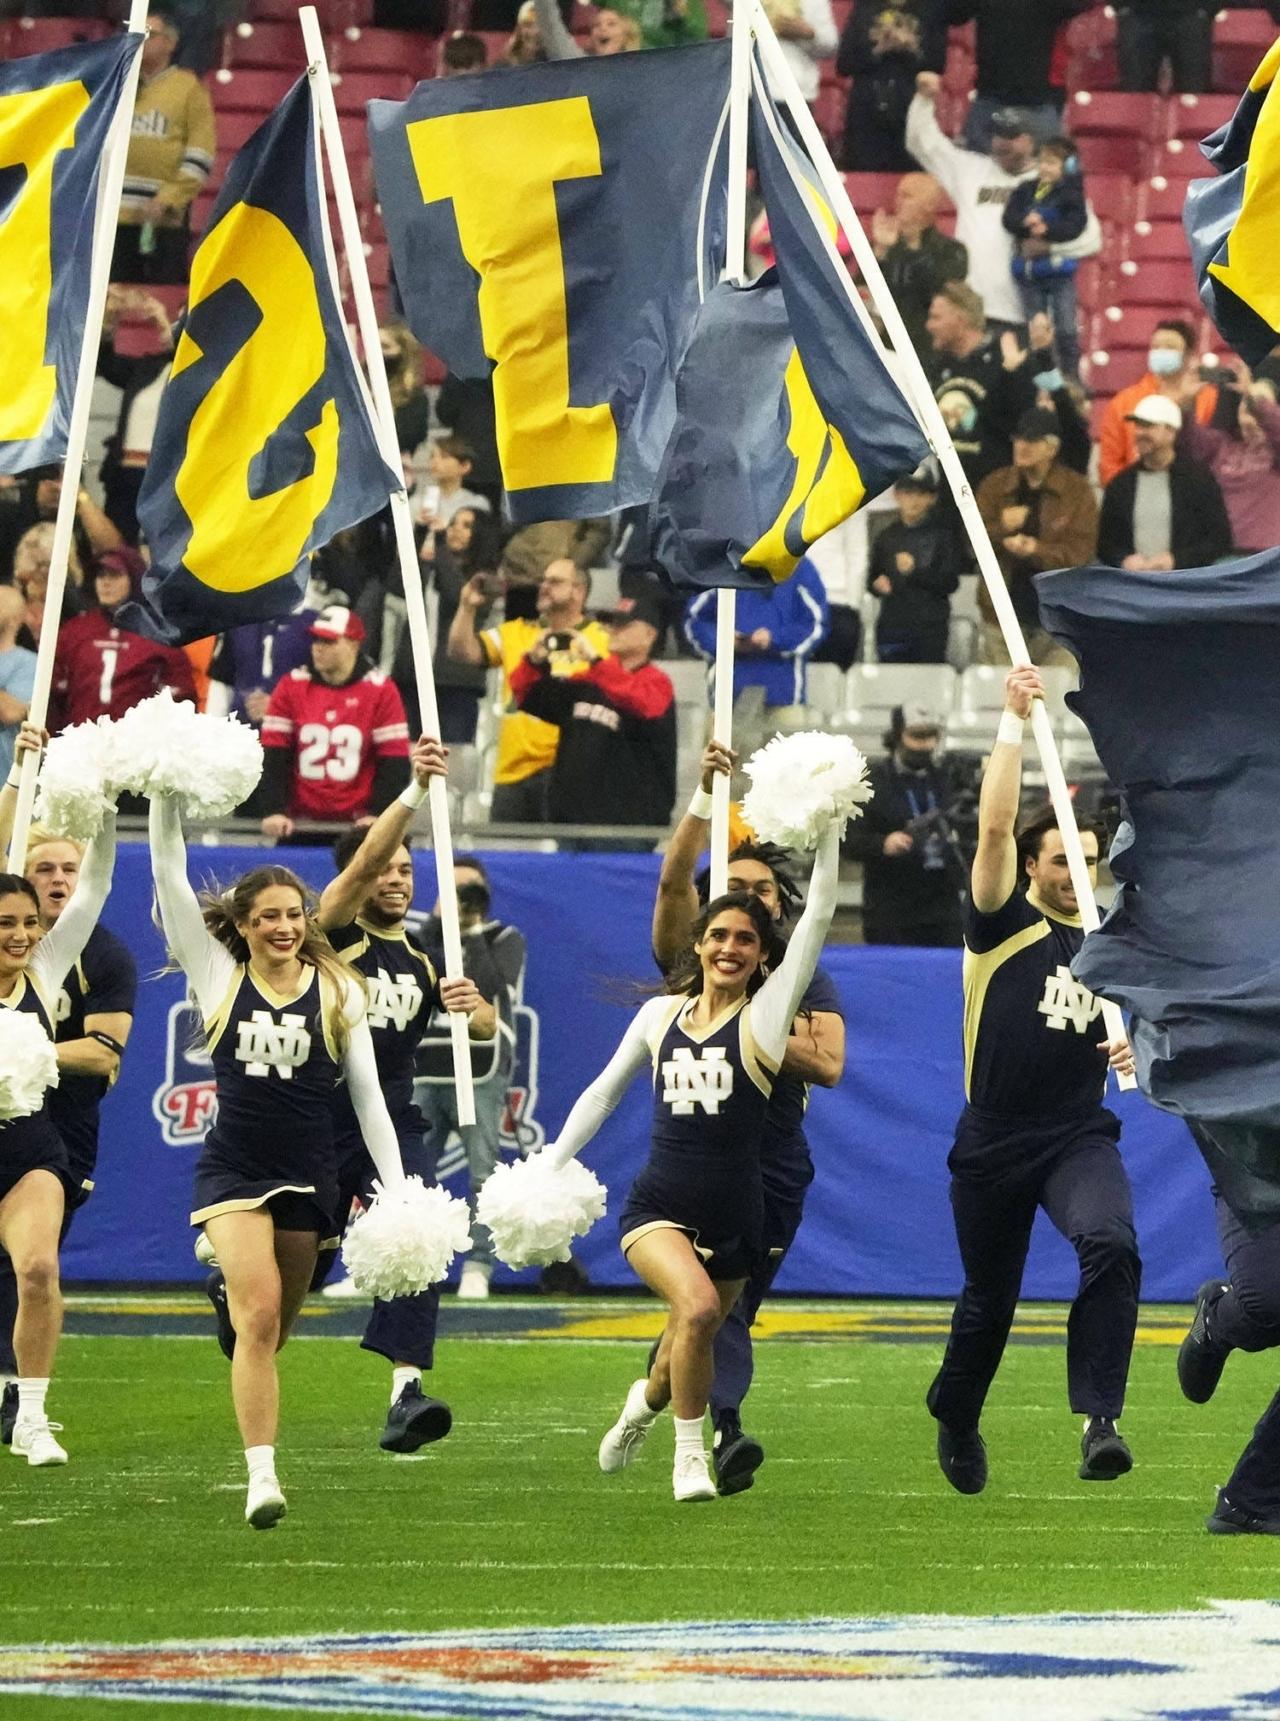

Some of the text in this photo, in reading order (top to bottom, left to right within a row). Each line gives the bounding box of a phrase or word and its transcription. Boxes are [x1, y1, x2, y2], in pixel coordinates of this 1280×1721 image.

[99, 649, 118, 704] 1
[263, 635, 273, 679] 1
[299, 722, 363, 782] 23
[235, 1009, 312, 1080] ND
[662, 1046, 734, 1115] ND
